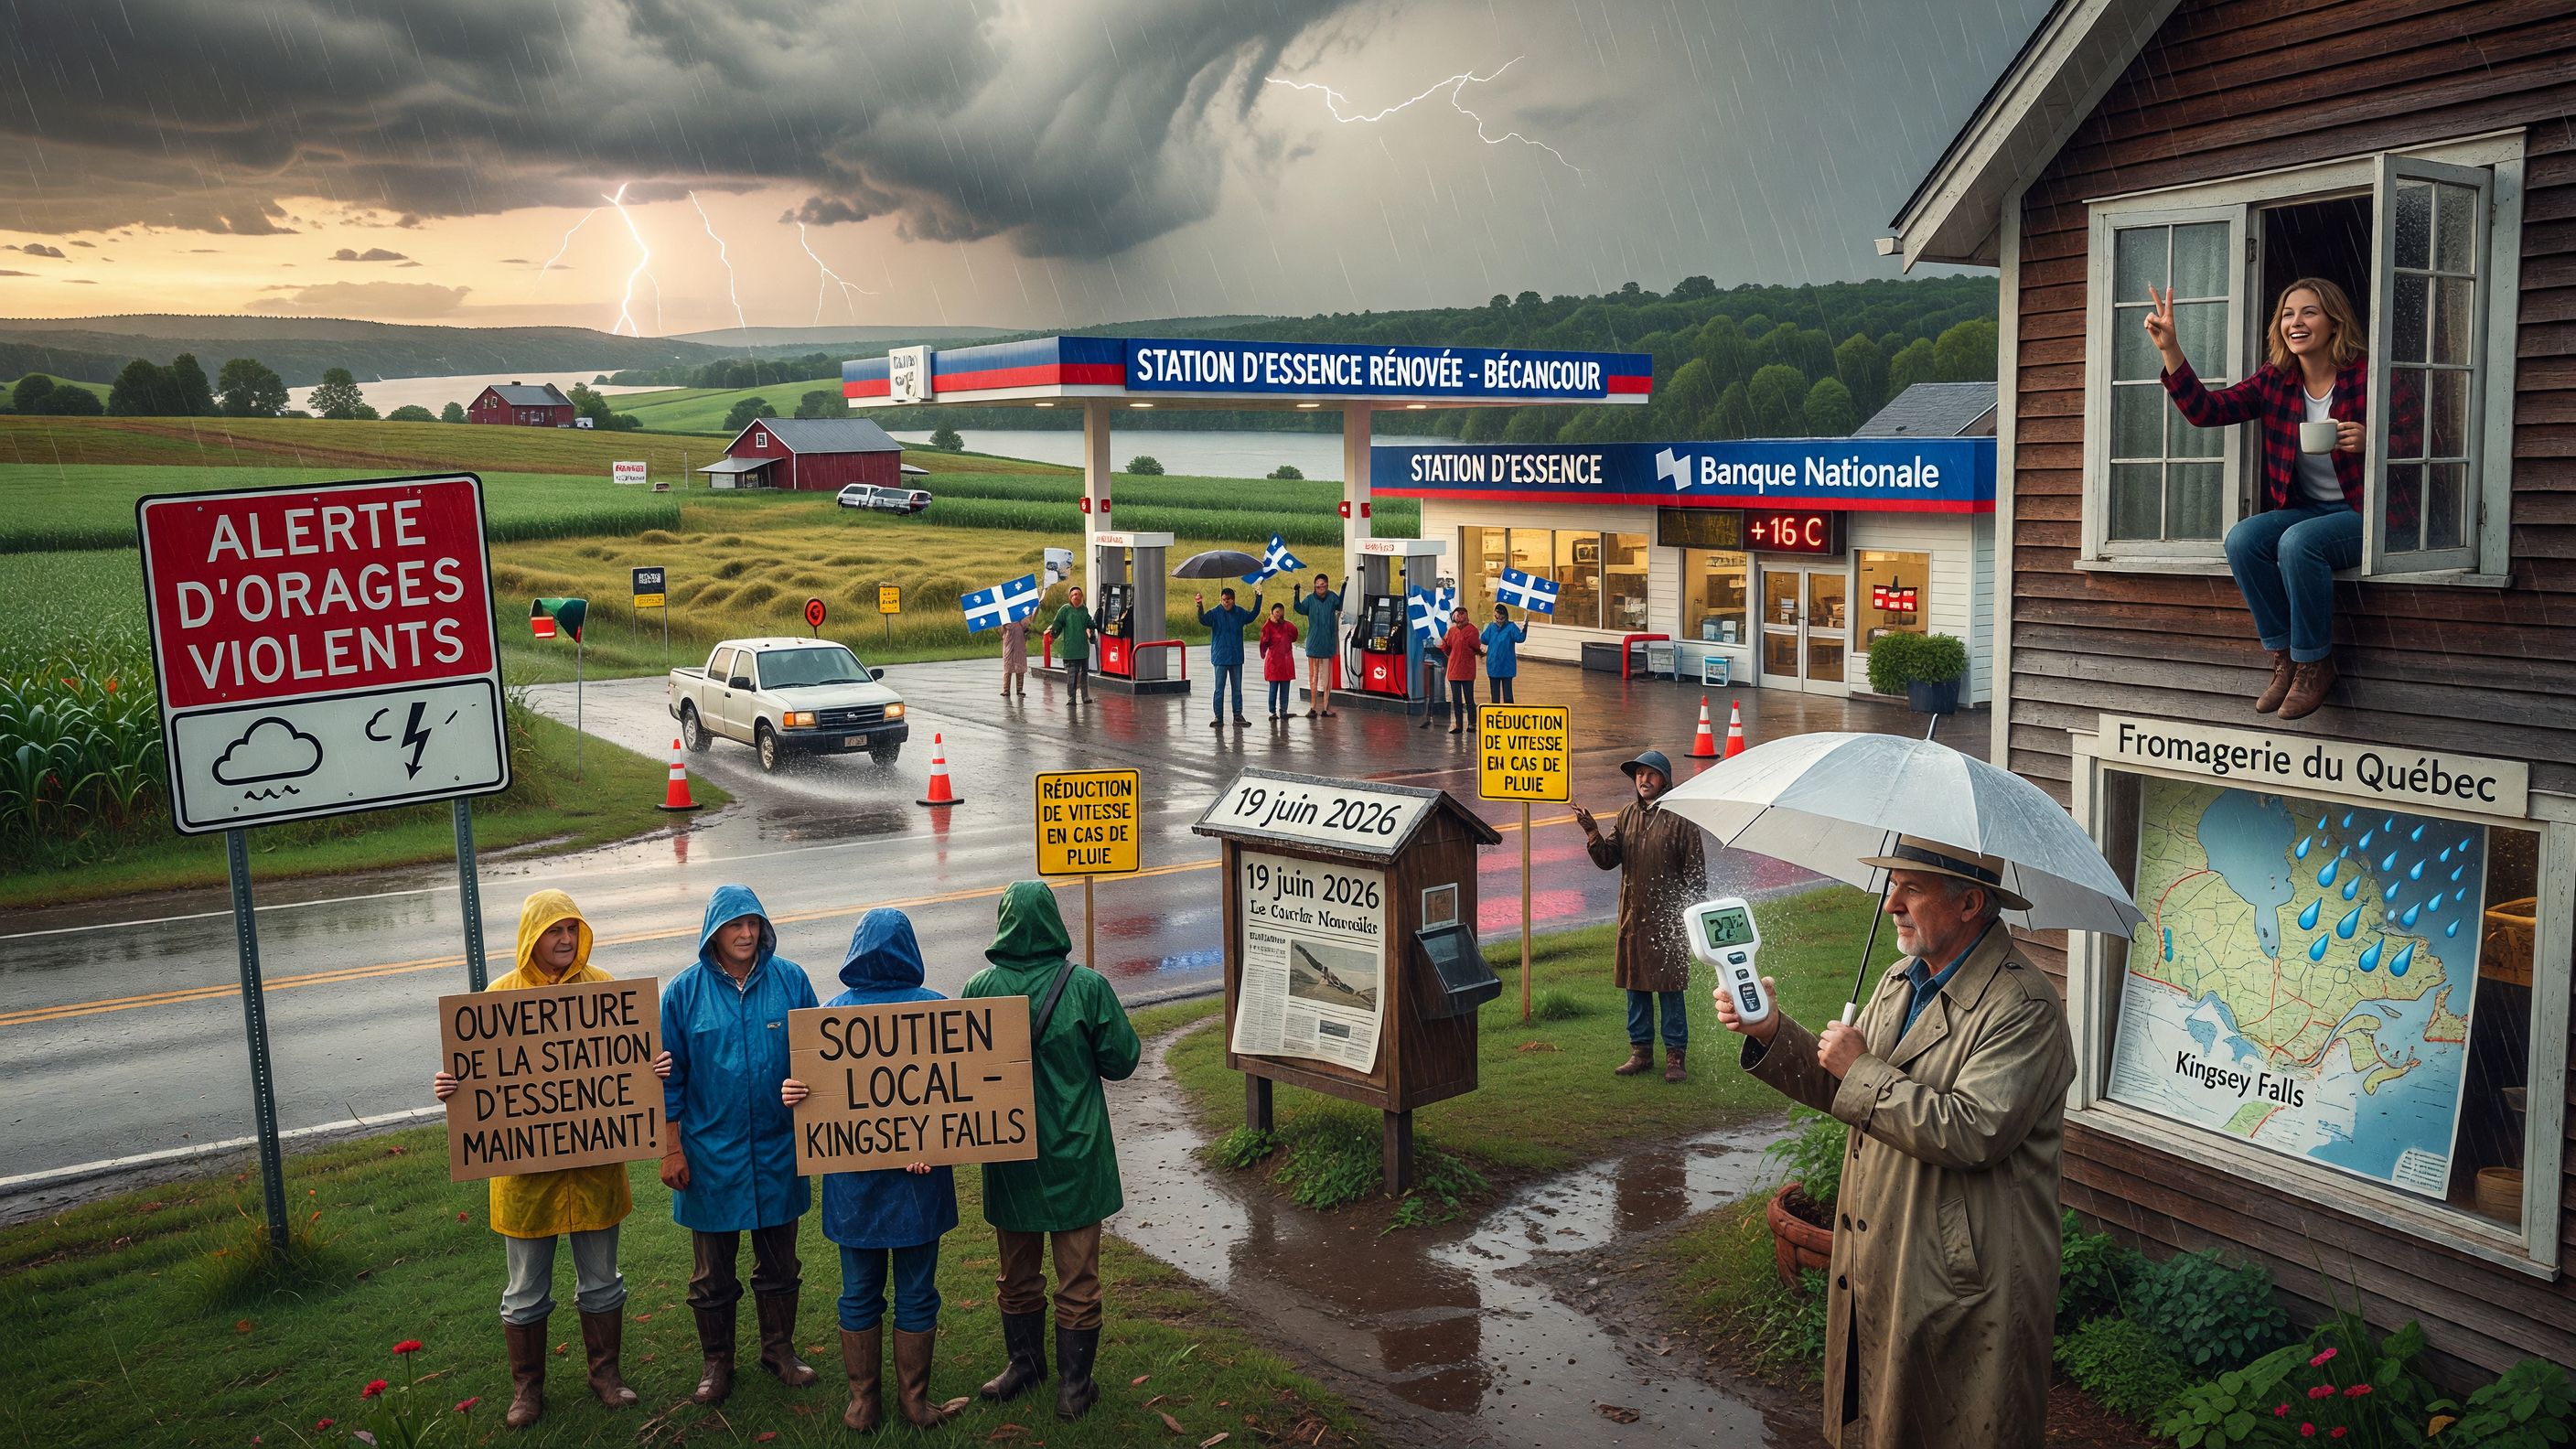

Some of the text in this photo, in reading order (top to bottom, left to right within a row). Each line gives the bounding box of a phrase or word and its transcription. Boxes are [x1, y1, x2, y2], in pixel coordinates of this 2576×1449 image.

[1137, 348, 1235, 383] STATION
[1242, 351, 1363, 386] D'ESSENCE
[1369, 348, 1464, 388] RÉNOVÉE
[1484, 351, 1601, 391] BÉCANCOUR
[1411, 453, 1603, 485] STATION D'ESSENCE
[1701, 455, 1939, 495] Banque Nationale
[207, 499, 426, 564] ALERTE
[1805, 517, 1822, 546] C
[176, 556, 465, 629] D'ORAGES
[188, 617, 465, 690] VIOLENTS
[1485, 735, 1563, 752] DE VITESSE
[1486, 710, 1562, 731] RÉDUCTION
[1487, 756, 1561, 773] EN CAS DE
[1504, 775, 1544, 793] PLUIE
[2118, 723, 2497, 803] Fromagerie du Québec
[1043, 778, 1132, 800] RÉDUCTION
[1043, 802, 1132, 822] DE VITESSE
[1233, 787, 1401, 836] 19 juin 2026
[1046, 824, 1129, 845] EN CAS DE
[1067, 847, 1112, 865] PLUIE
[1246, 863, 1380, 910] 19 juin 2026
[455, 990, 639, 1042] OUVERTURE
[819, 1008, 993, 1062] SOUTIEN
[454, 1030, 651, 1082] DE LA STATION
[2175, 1050, 2304, 1109] Kingsey Falls
[476, 1071, 635, 1122] D'ESSENCE
[846, 1060, 974, 1111] LOCAL
[806, 1108, 1026, 1159] KINGSEY FALLS
